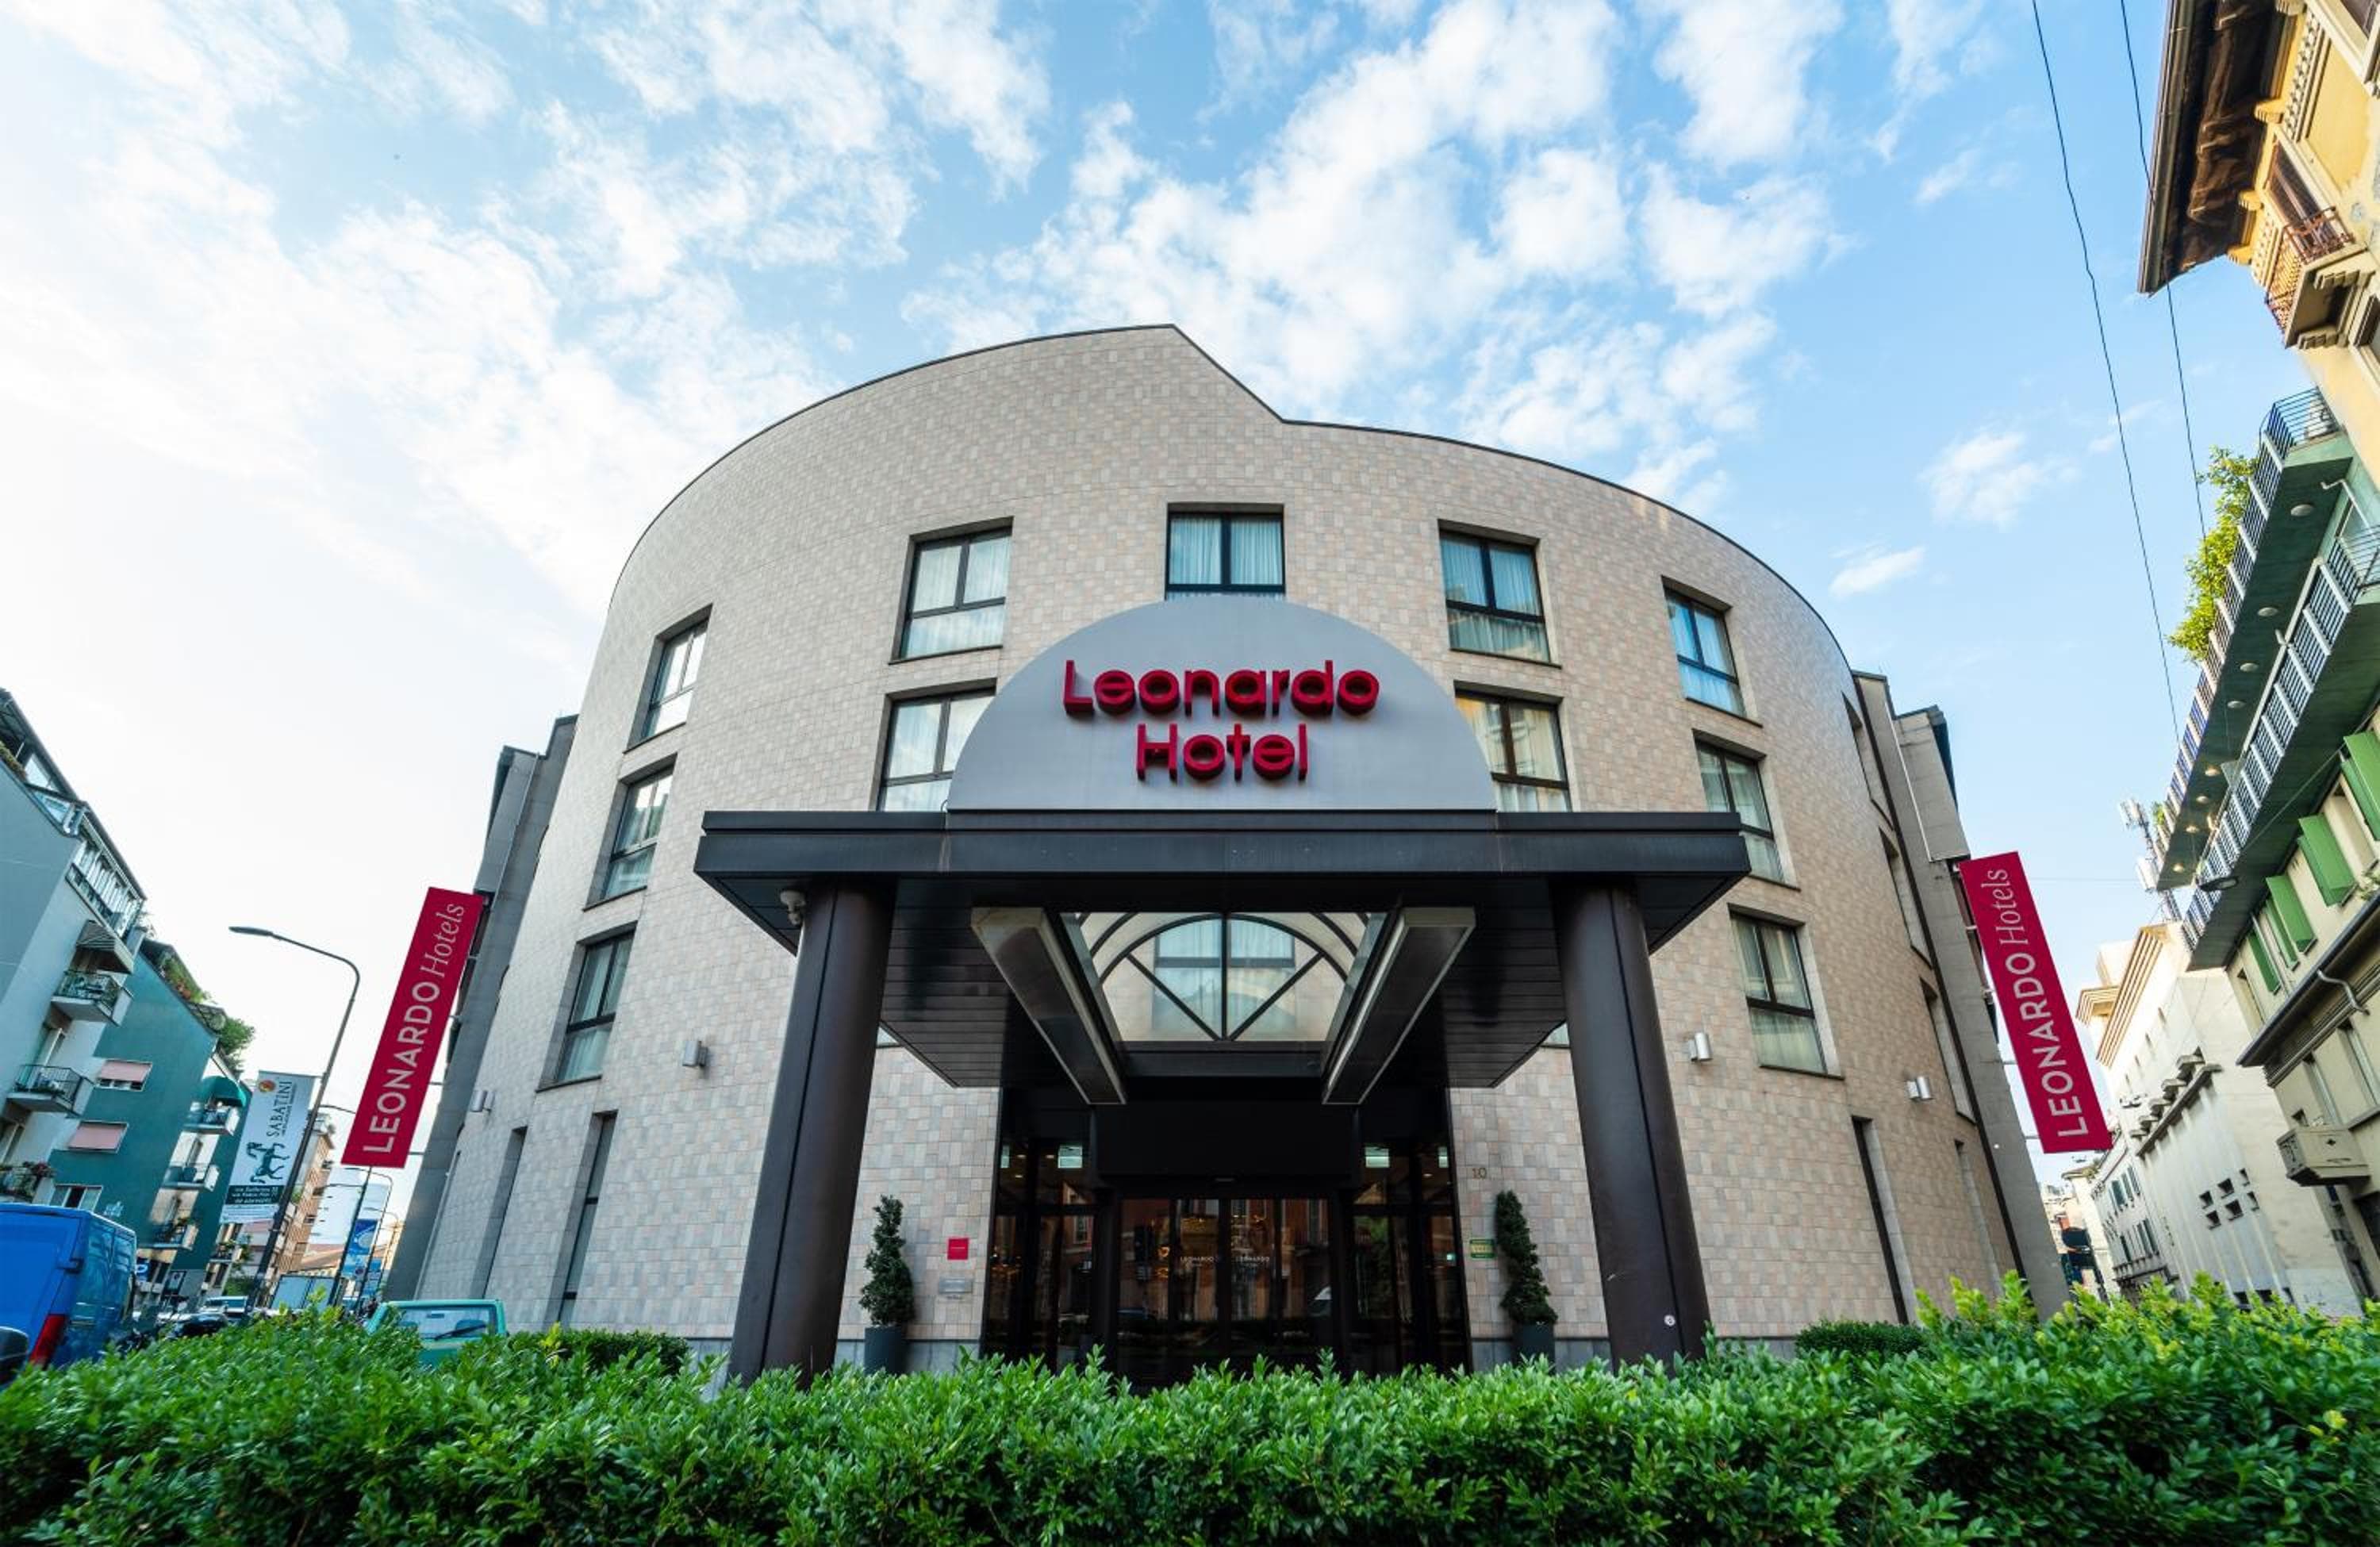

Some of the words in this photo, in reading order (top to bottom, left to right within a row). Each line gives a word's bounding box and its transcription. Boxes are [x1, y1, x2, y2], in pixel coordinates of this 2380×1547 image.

[1063, 660, 1380, 716] Leonardo
[1137, 724, 1308, 781] Hotel
[1981, 868, 2028, 946] Hotels
[363, 981, 440, 1154] LEONARDO
[420, 903, 465, 978] Hotels
[2004, 952, 2089, 1138] LEONARDO
[267, 1081, 293, 1137] SABATINI
